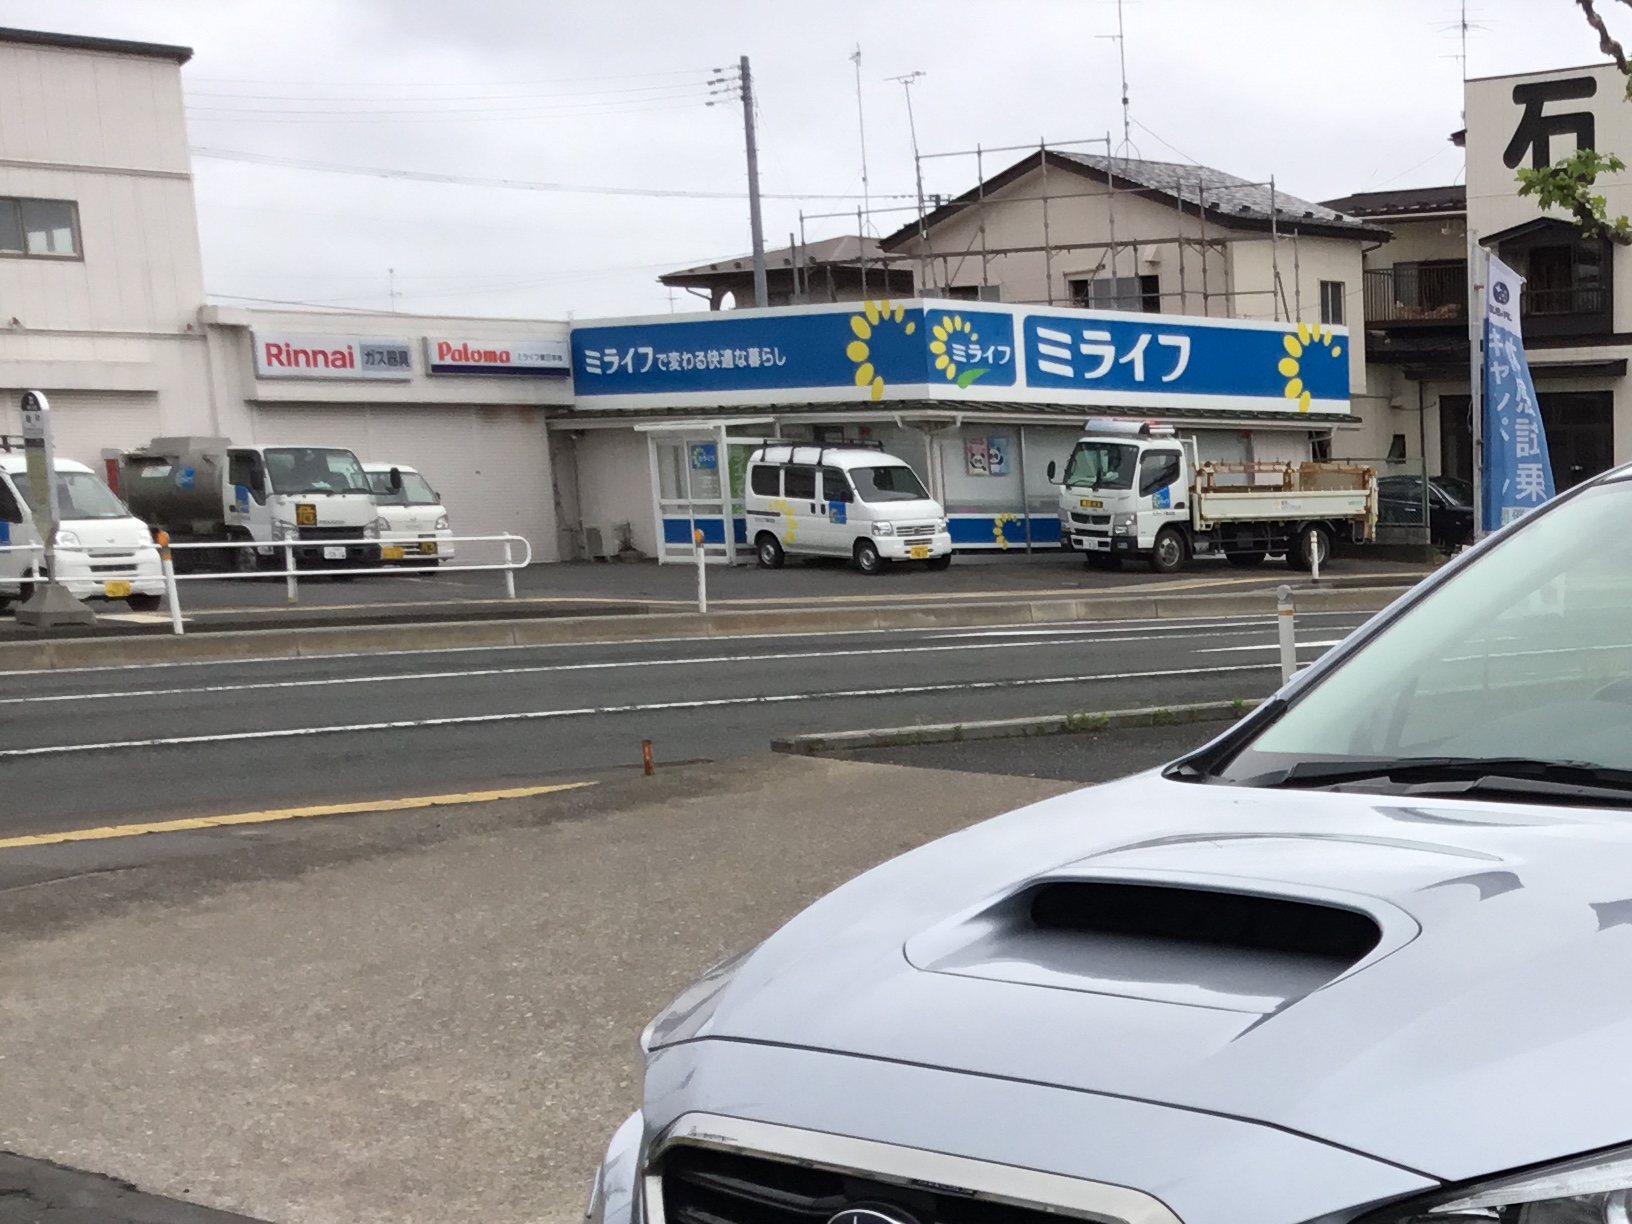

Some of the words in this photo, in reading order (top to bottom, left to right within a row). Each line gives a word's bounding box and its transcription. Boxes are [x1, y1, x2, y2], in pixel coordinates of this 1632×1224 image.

[264, 342, 355, 368] Rinnai
[437, 341, 511, 363] Paloma
[584, 346, 787, 374] ミライフで変わる快適な暮らし
[952, 343, 1011, 364] ミライフ
[1036, 326, 1191, 383] ミライフ
